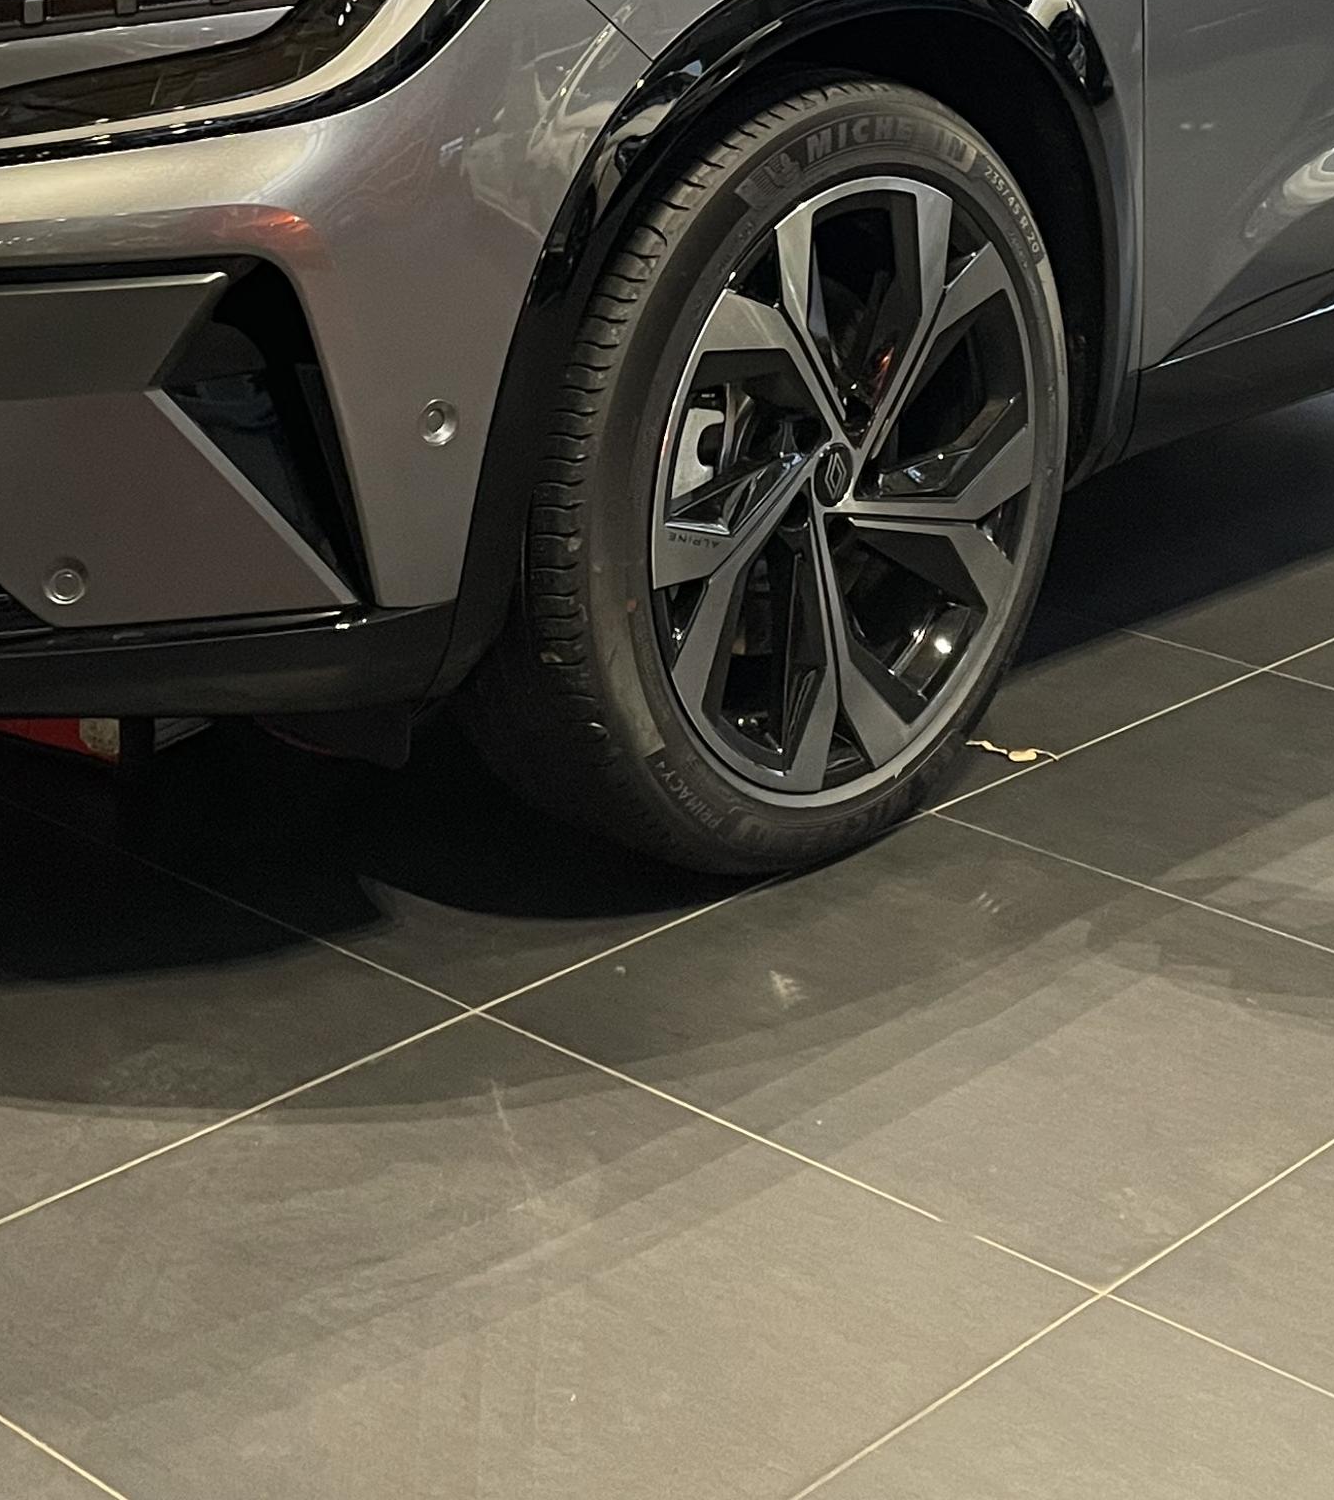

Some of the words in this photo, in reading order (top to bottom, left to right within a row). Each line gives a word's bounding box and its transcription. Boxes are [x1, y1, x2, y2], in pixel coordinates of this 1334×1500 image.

[806, 116, 967, 164] MICHEIN
[668, 531, 721, 548] ALPINE
[661, 770, 725, 829] PRIMACY
